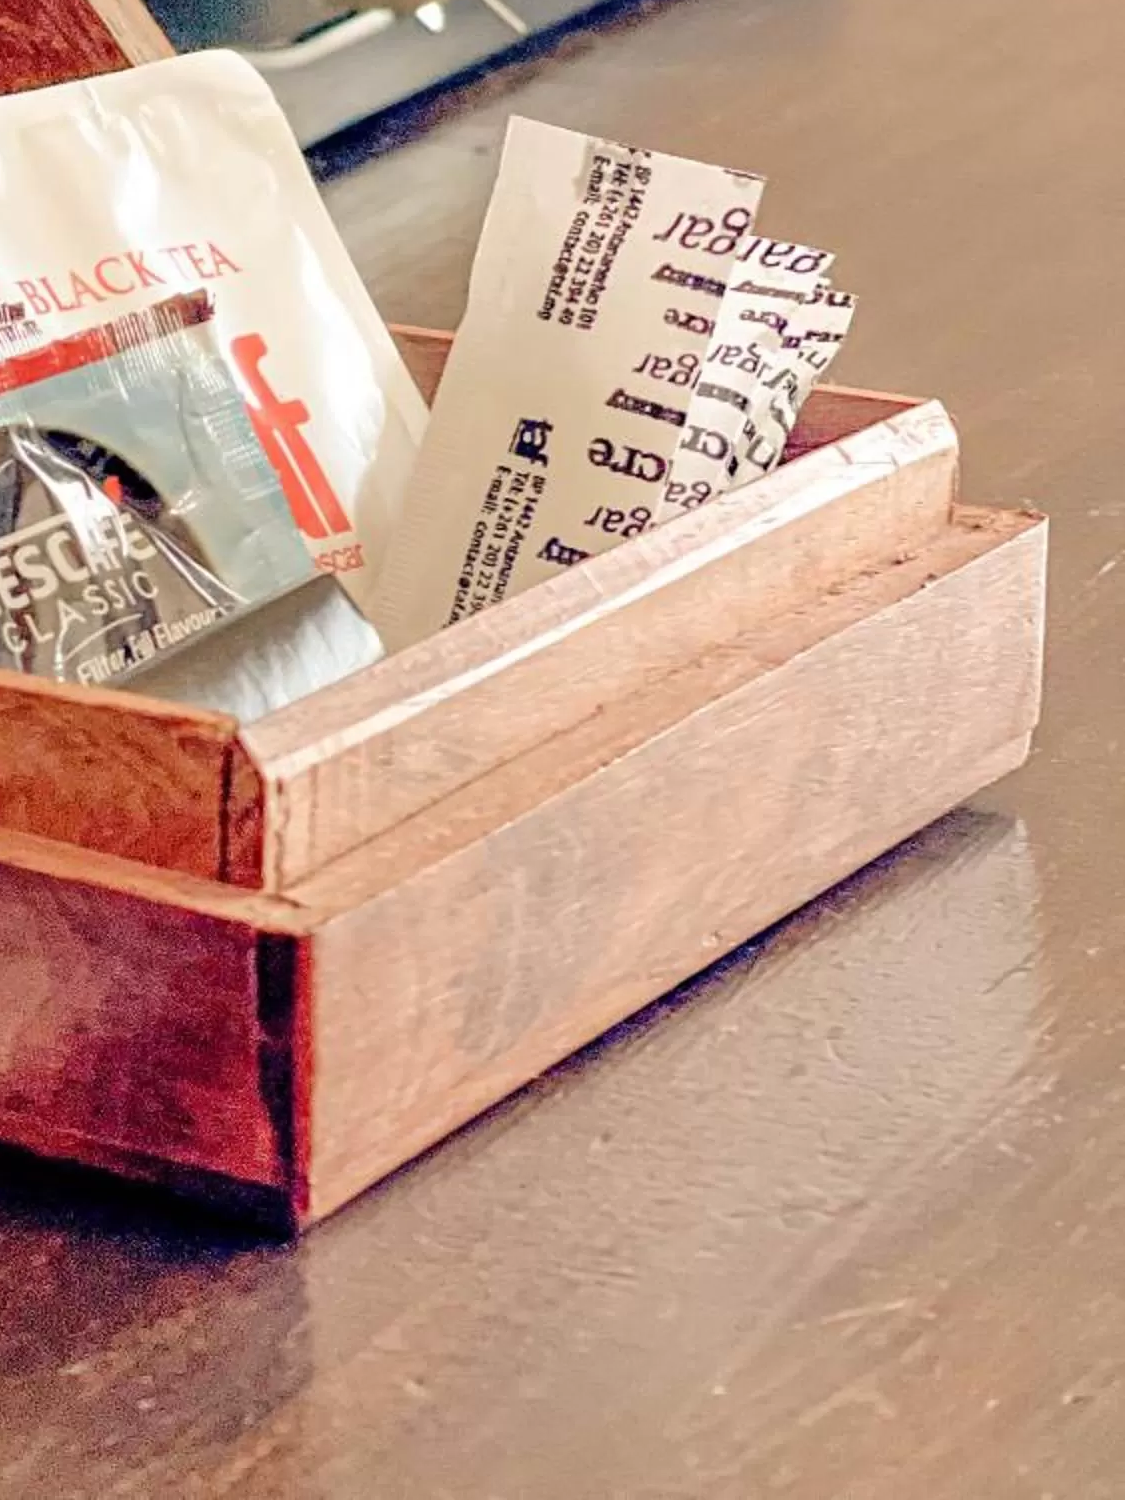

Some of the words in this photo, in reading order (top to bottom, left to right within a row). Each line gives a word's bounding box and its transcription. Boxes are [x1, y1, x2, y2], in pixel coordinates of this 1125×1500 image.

[14, 250, 168, 317] BLACK
[159, 240, 244, 281] TEA
[1, 569, 161, 653] CLASSIC
[476, 568, 495, 591] 22
